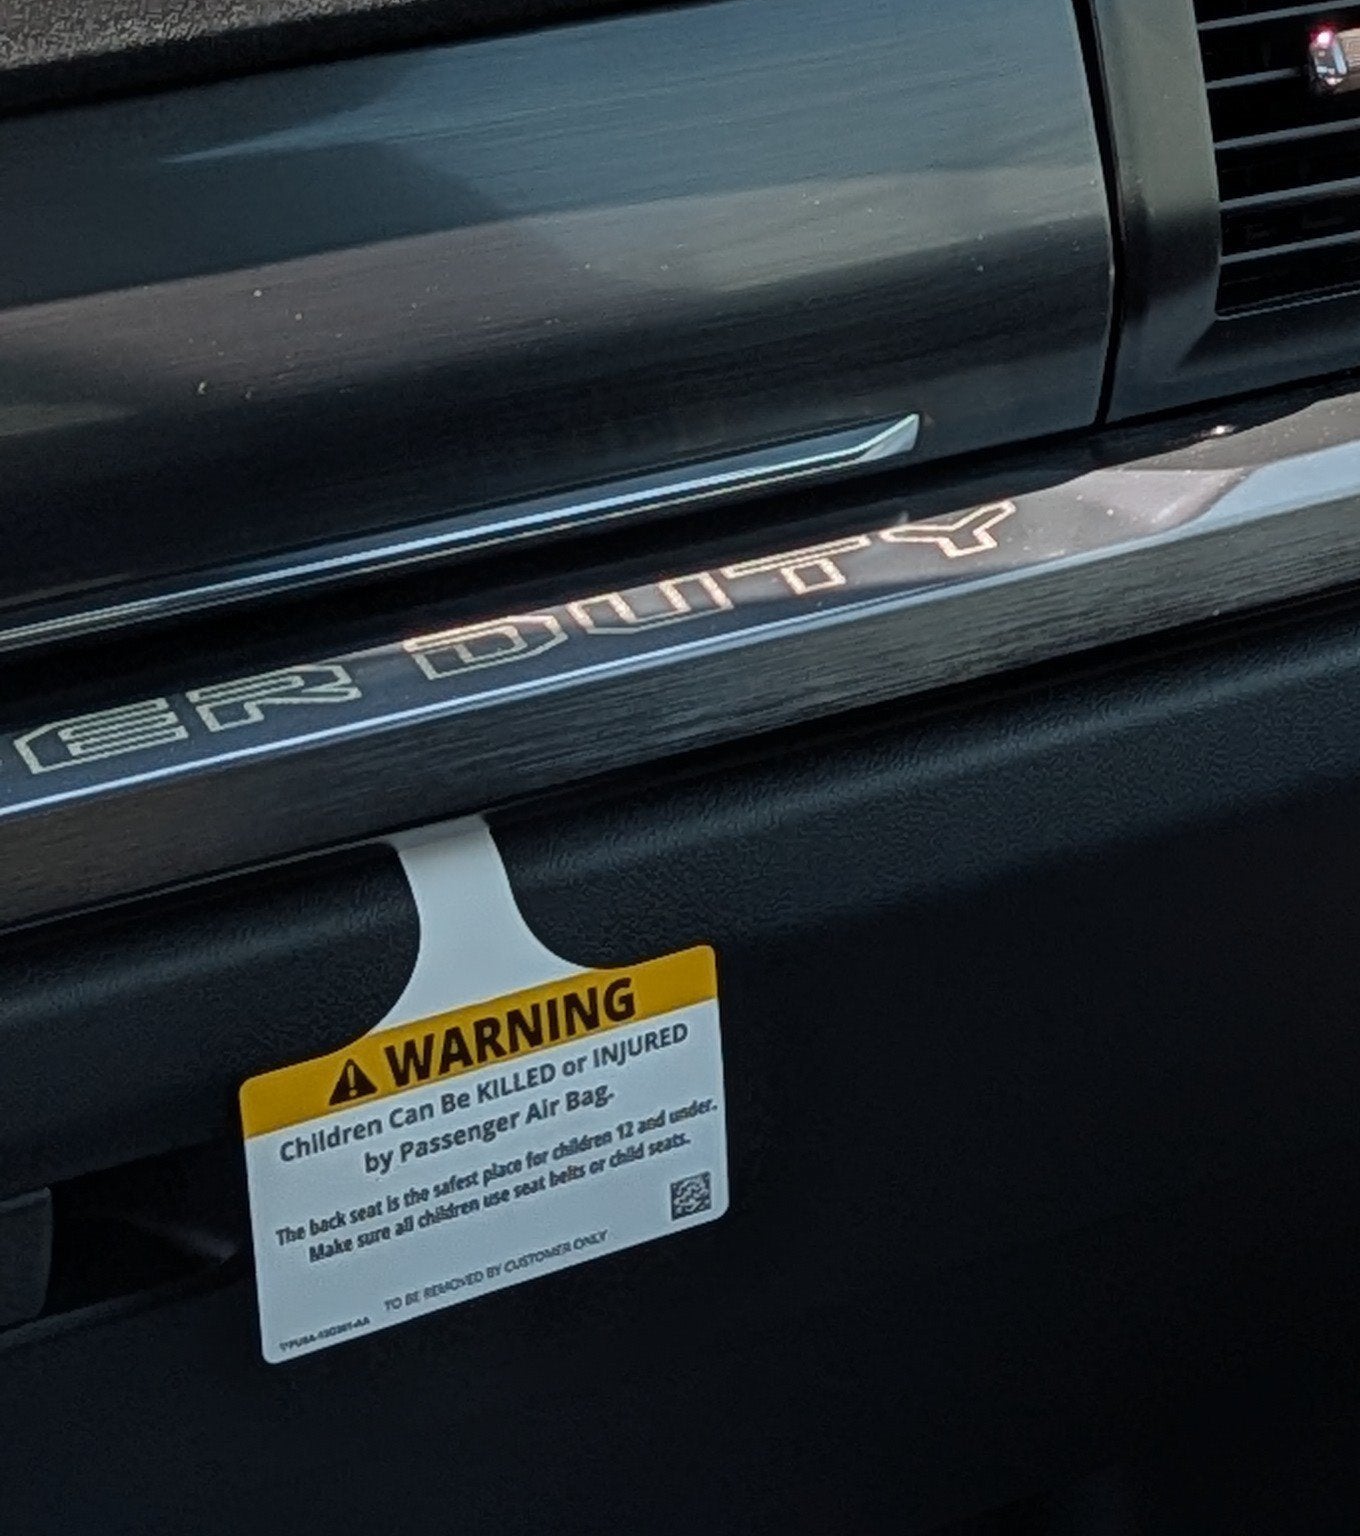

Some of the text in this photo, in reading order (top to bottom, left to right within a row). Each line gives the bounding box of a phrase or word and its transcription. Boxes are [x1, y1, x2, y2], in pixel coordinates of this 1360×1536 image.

[402, 499, 1018, 682] DUTY
[279, 1022, 688, 1162] Children Can Be KILLED or INJURED
[383, 977, 636, 1088] WARNING
[275, 1098, 718, 1246] The back seat is the safest place for children 12 and under.
[364, 1084, 615, 1175] by Passenger Air Bag.
[309, 1132, 691, 1263] Make sure all children use seat belts or child seats.
[384, 1229, 608, 1311] TO BE REMOVED BY CUSTOMER ONLY
